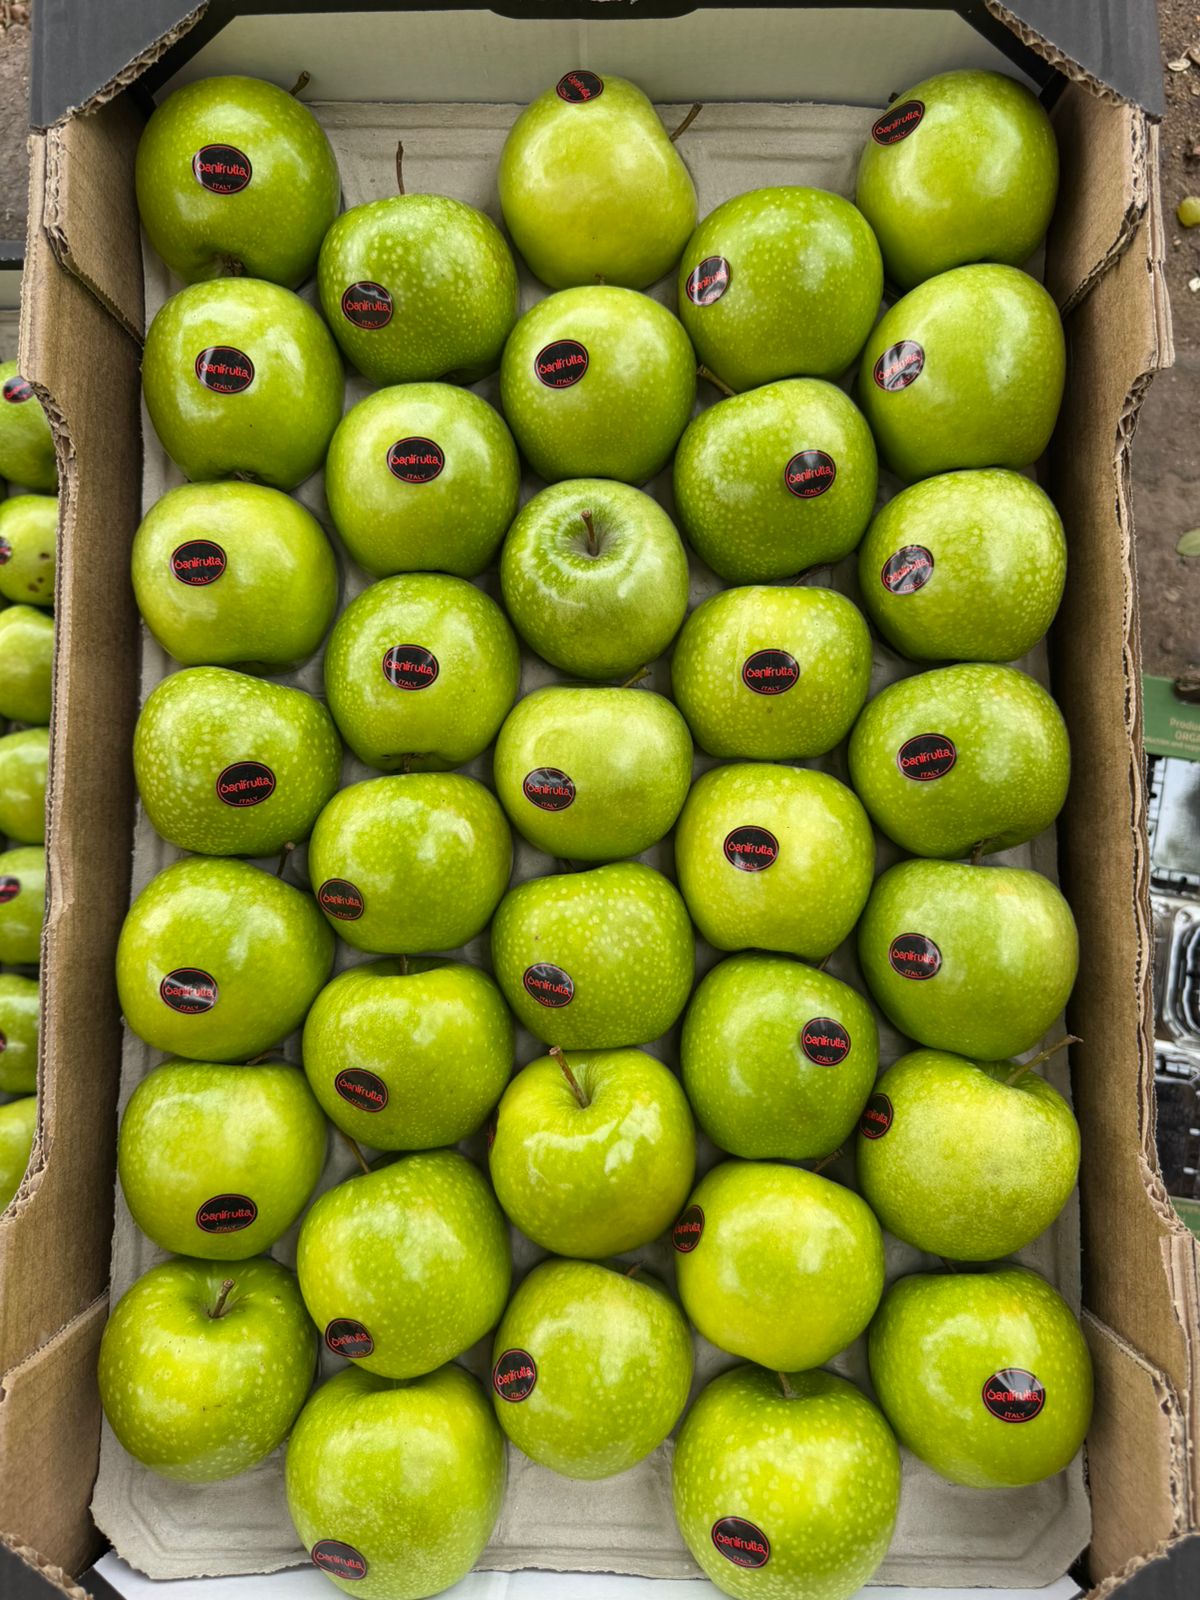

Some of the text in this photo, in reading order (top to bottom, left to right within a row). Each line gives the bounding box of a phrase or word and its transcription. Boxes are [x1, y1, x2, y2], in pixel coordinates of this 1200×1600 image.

[211, 182, 231, 190] ITALY
[556, 376, 573, 385] ITALY
[212, 382, 232, 390] ITALY
[804, 487, 820, 495] ITALY
[190, 575, 208, 583] ITALY
[920, 770, 939, 778] ITALY
[239, 796, 258, 804] ITALY
[540, 997, 556, 1005] ITALY
[511, 1390, 526, 1398] ITALY
